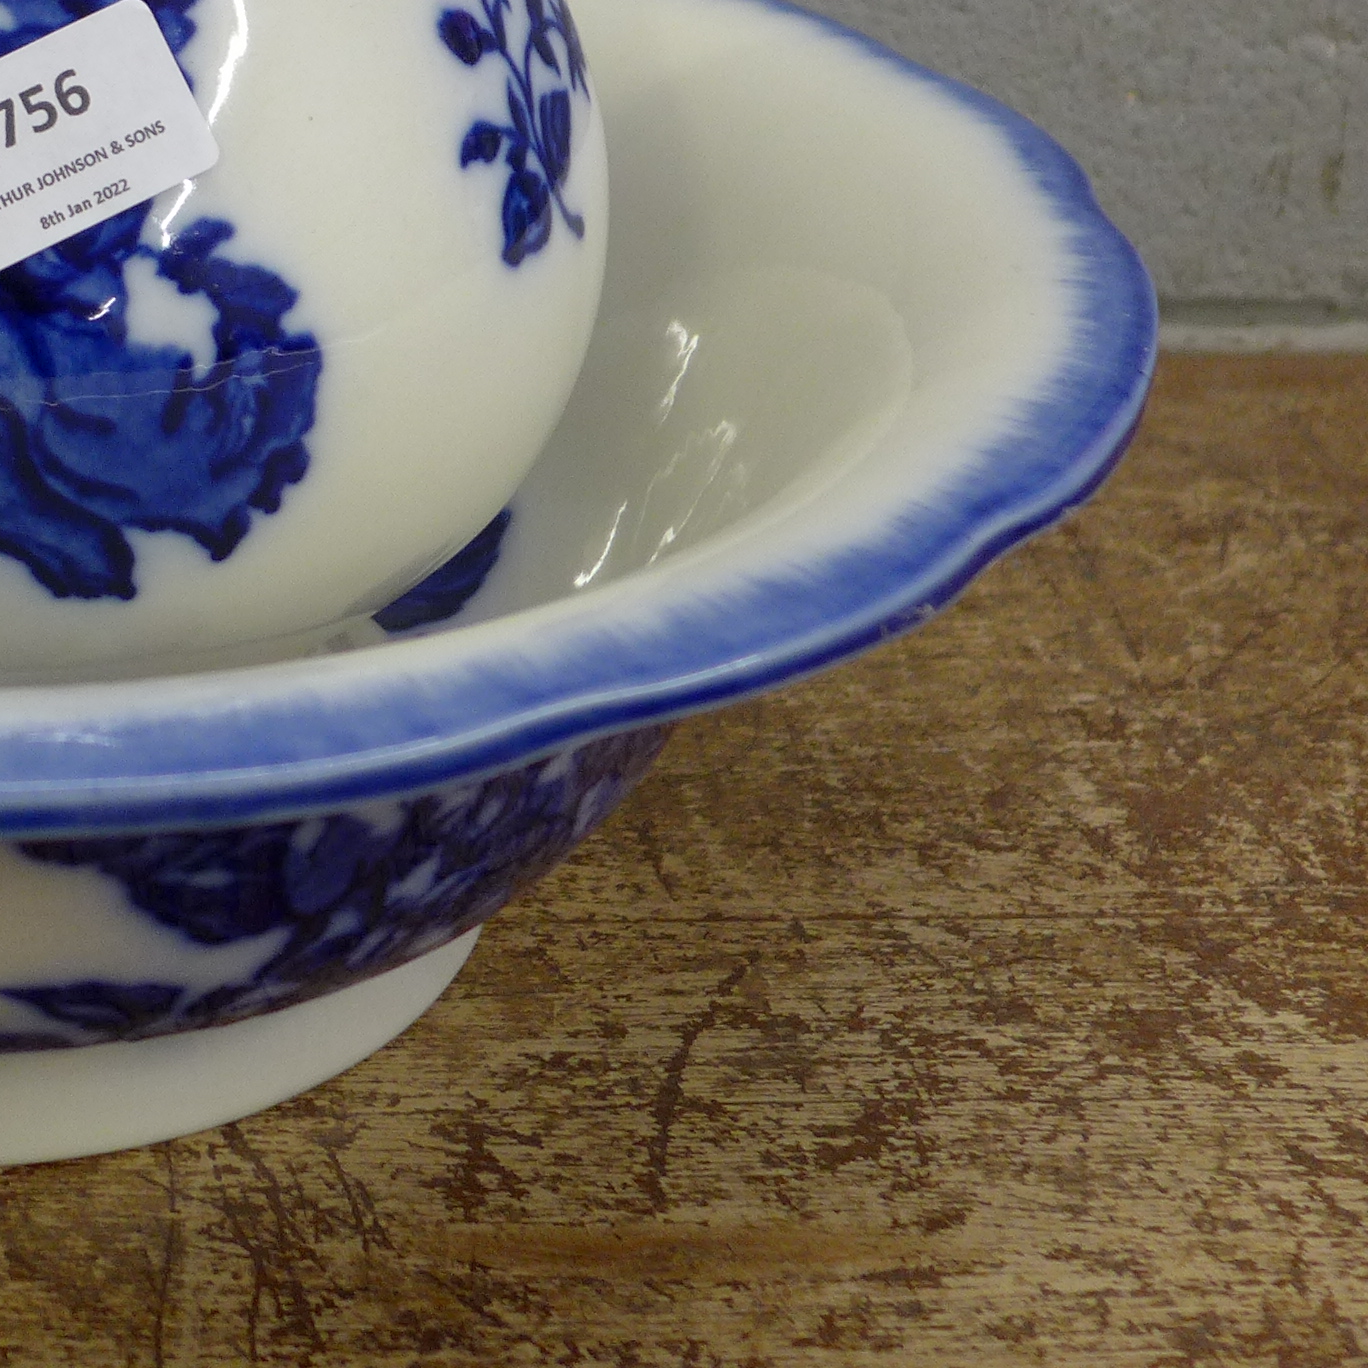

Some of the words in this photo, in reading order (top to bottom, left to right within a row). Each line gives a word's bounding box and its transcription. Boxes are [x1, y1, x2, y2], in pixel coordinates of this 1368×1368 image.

[36, 146, 109, 191] JOHNSON
[110, 140, 125, 155] &
[127, 120, 166, 148] SONS
[39, 209, 66, 230] 8th
[67, 198, 93, 218] Jan
[92, 178, 131, 205] 2022
